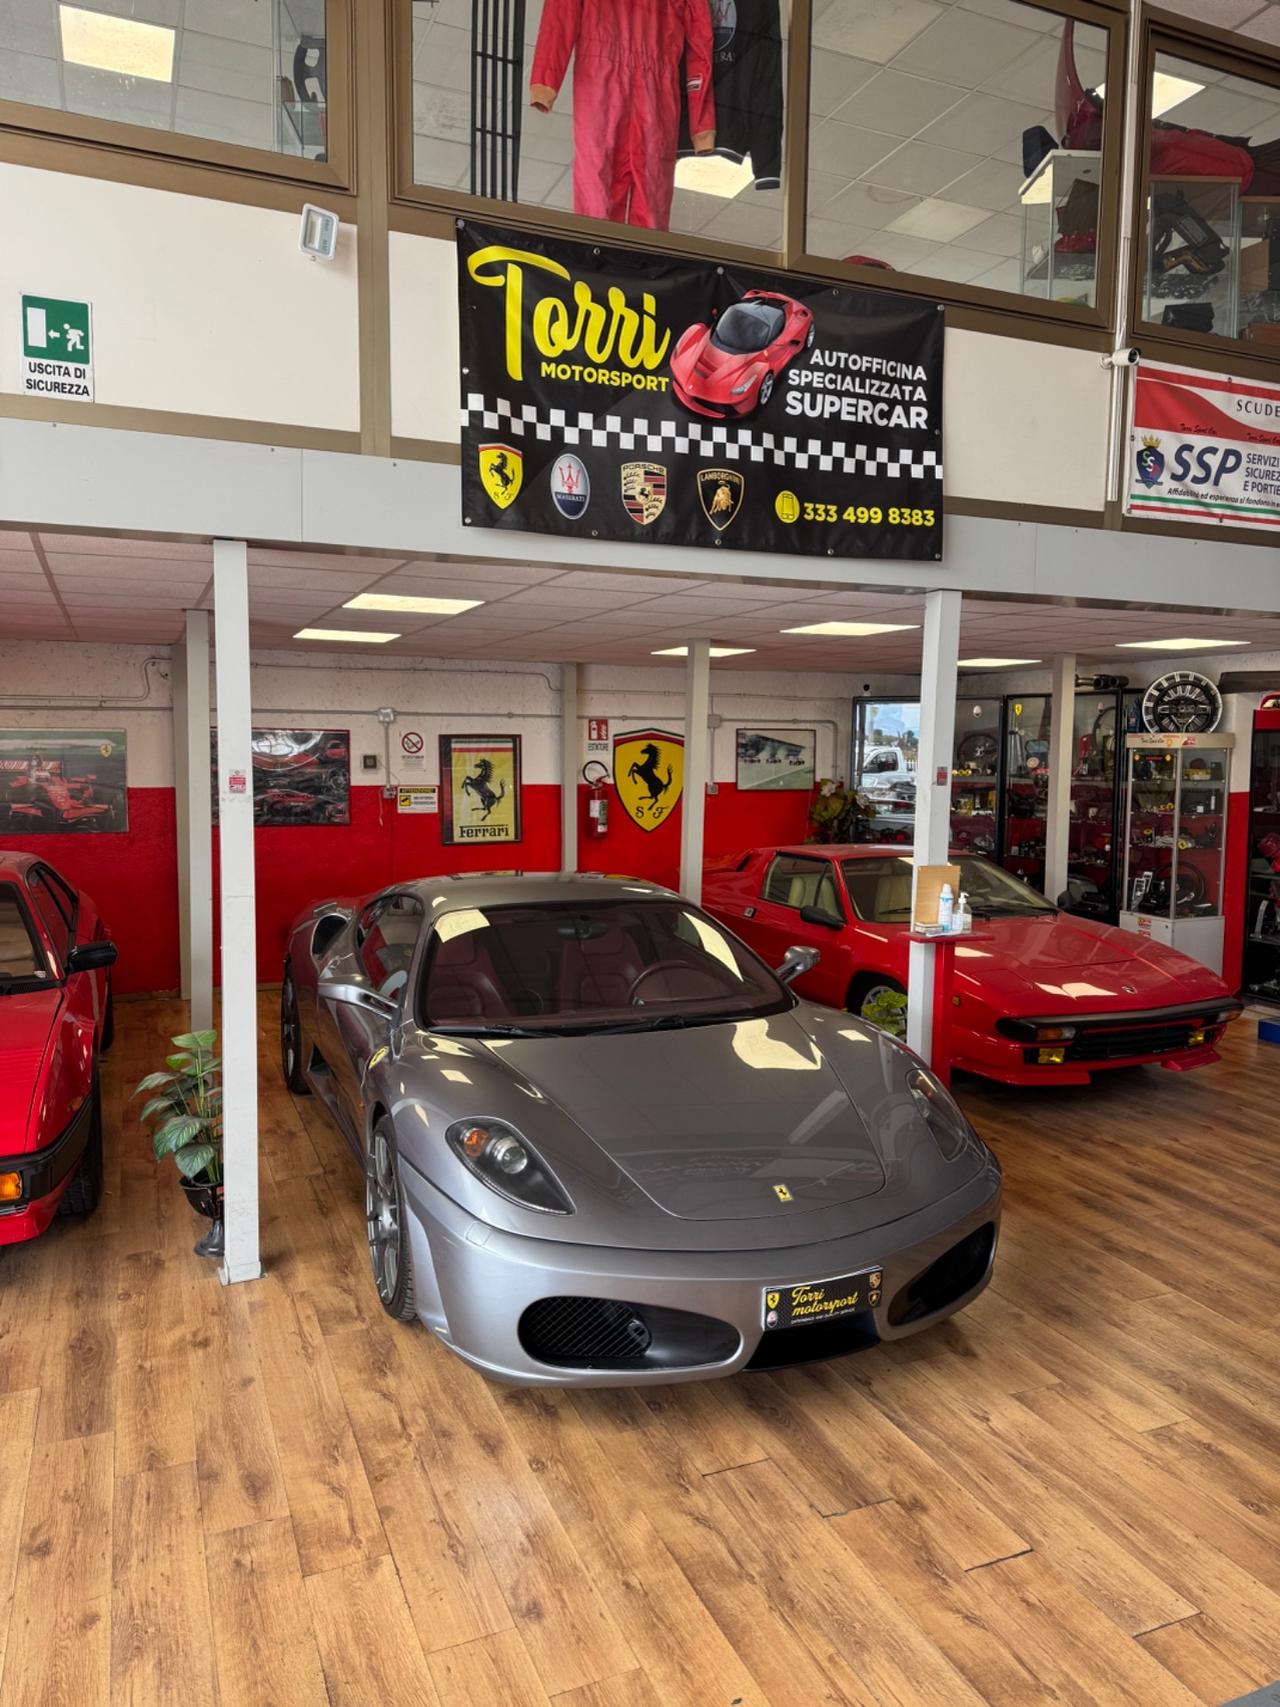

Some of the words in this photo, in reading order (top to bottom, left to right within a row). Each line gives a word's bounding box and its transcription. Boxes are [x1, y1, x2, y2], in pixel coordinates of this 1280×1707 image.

[467, 245, 671, 381] Torri
[28, 361, 71, 378] USCITA
[73, 367, 86, 380] DI
[541, 362, 669, 392] MOTORSPORT
[810, 349, 927, 381] AUTOFFICINA
[26, 378, 90, 396] SICUREZZA
[788, 369, 927, 401] SPECIALIZZATA
[785, 390, 928, 429] SUPERCAR
[1170, 444, 1242, 487] SSP
[1246, 453, 1280, 467] SERVIZI
[1200, 491, 1209, 500] ed
[1243, 480, 1250, 491] E
[803, 502, 838, 522] 333
[842, 506, 883, 524] 499
[887, 507, 935, 527] 8383
[459, 824, 509, 838] Ferrari
[791, 1286, 825, 1306] Torri
[791, 1291, 859, 1316] motorsport
